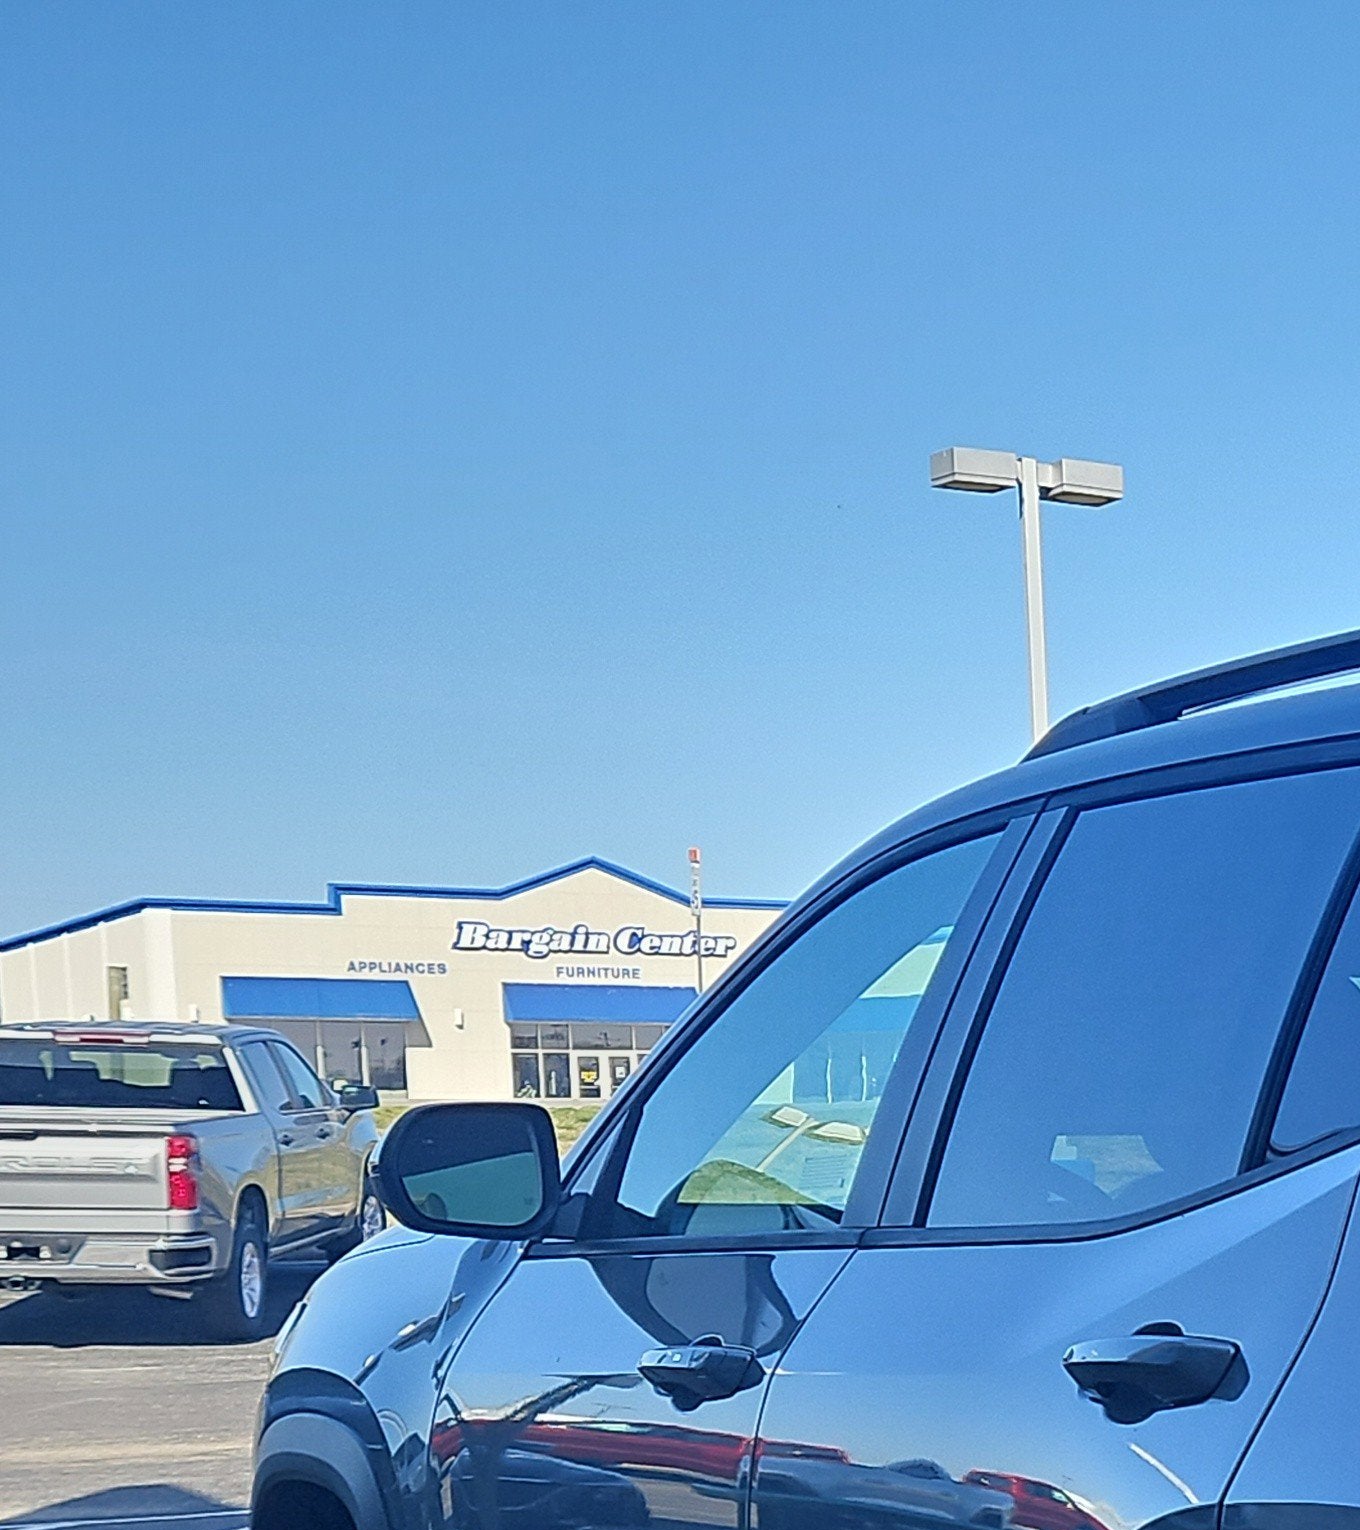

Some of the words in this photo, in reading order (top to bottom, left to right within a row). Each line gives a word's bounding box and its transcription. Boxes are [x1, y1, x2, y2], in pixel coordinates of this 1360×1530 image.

[452, 921, 609, 958] Bargain
[613, 926, 737, 958] Center
[346, 960, 448, 975] APPLIANCES
[556, 965, 641, 979] FURNITURE
